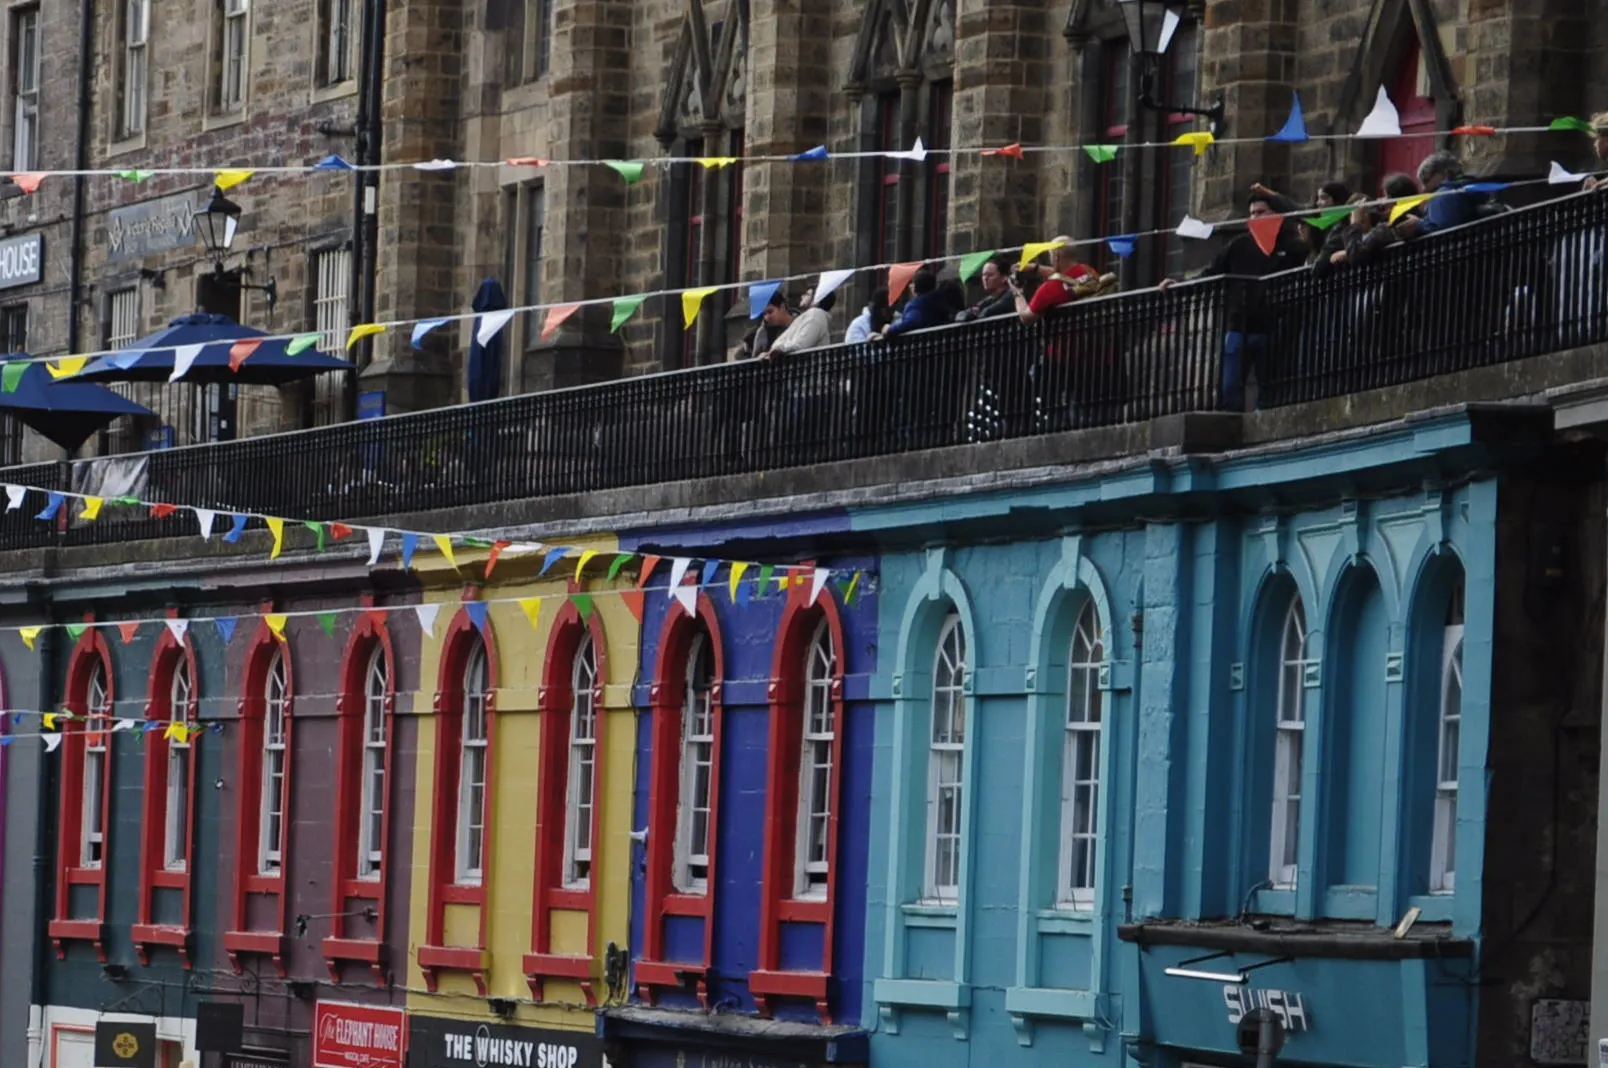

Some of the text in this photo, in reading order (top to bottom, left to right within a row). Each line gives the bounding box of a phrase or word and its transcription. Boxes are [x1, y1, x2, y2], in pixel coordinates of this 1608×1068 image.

[336, 1018, 374, 1048] ELEPHANT
[374, 1023, 399, 1051] HOUSE
[444, 1033, 472, 1061] THE
[476, 1036, 534, 1068] WHISKY
